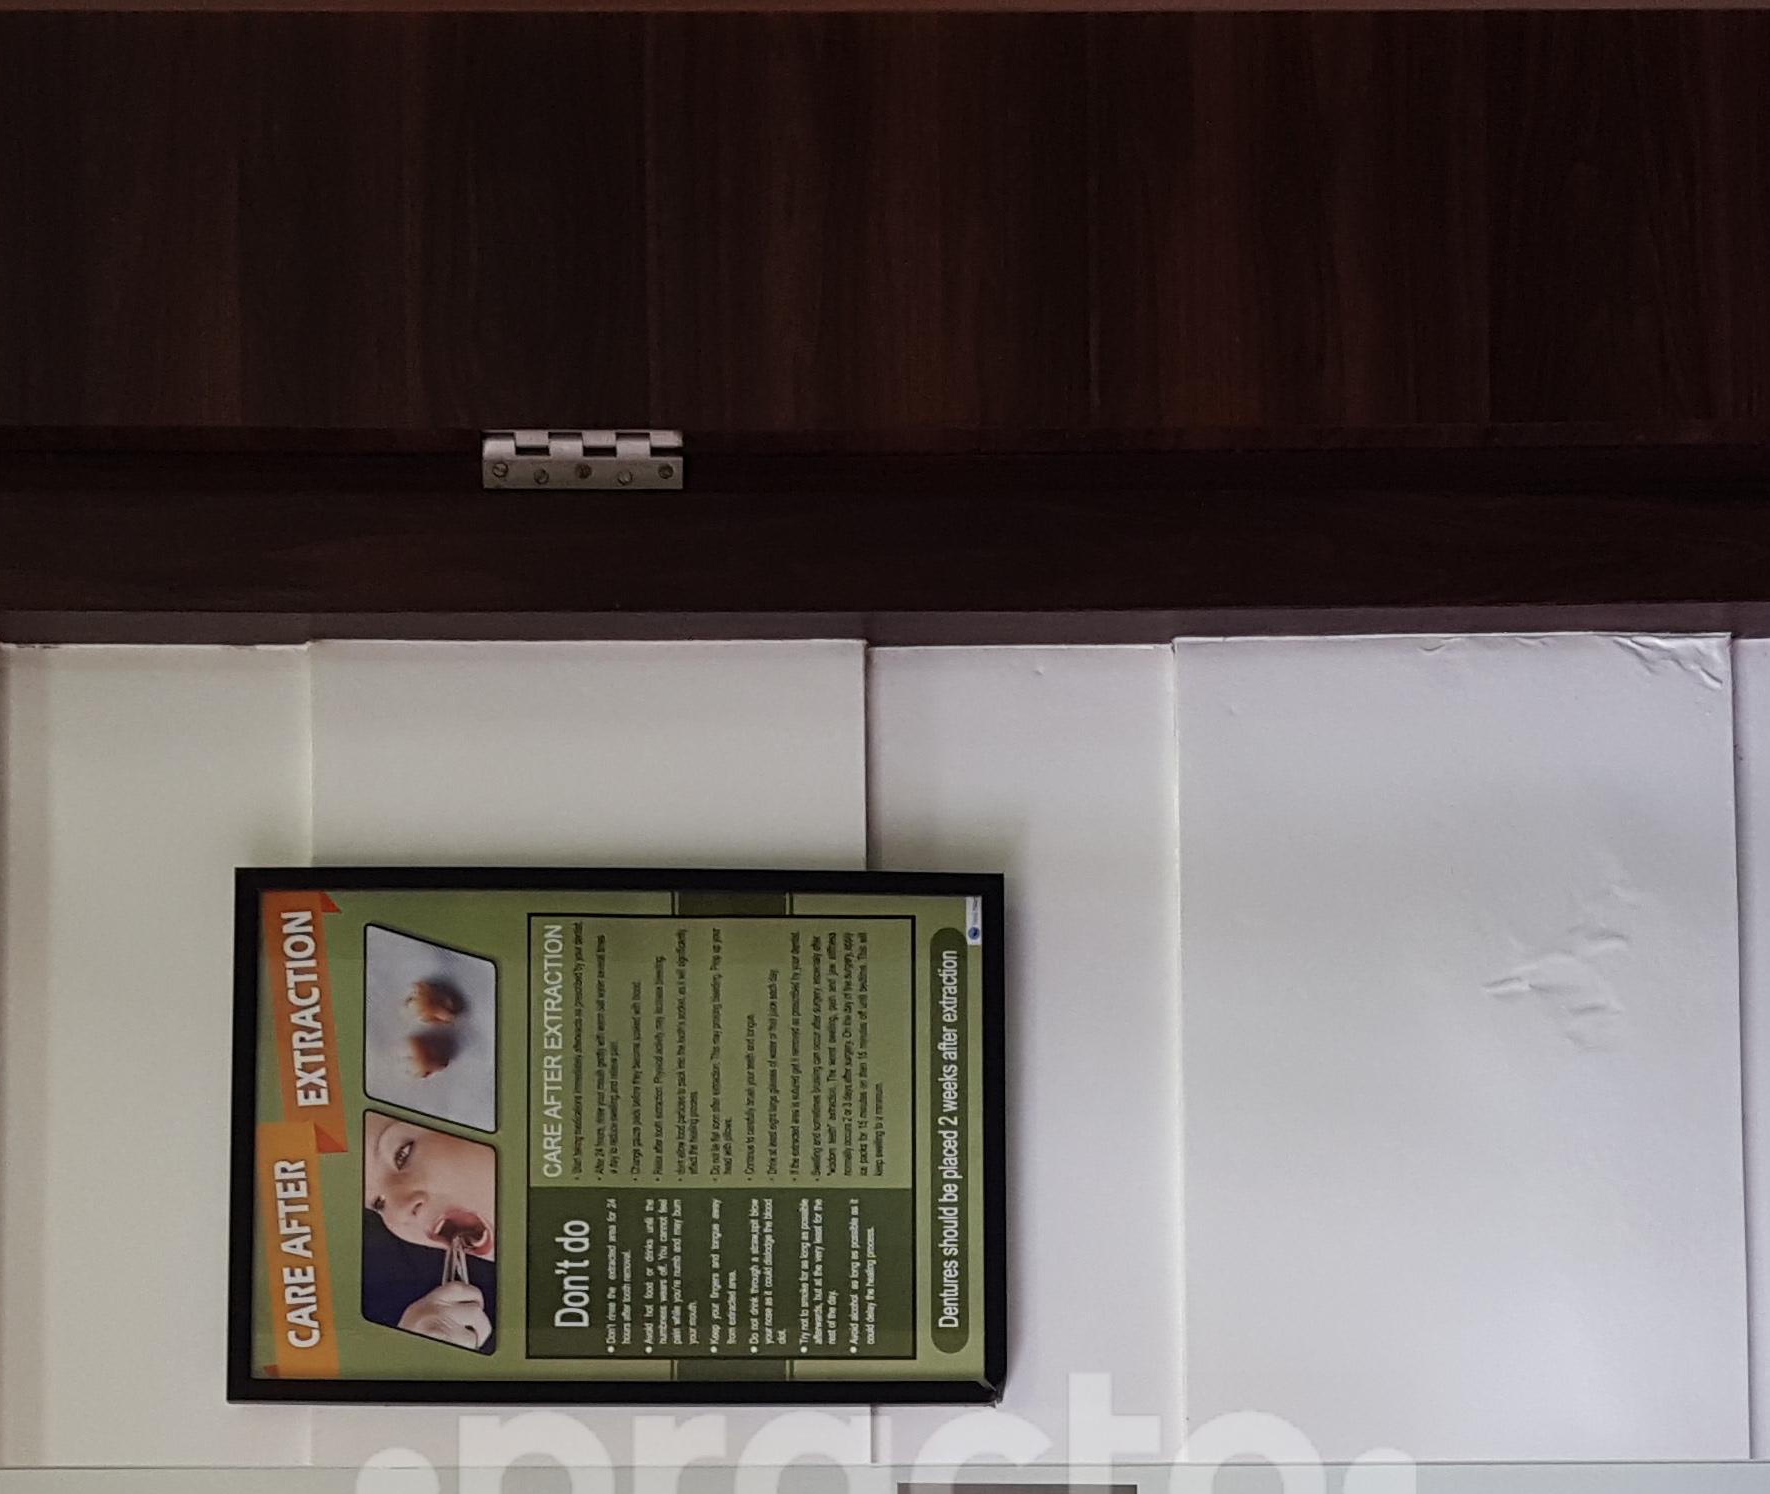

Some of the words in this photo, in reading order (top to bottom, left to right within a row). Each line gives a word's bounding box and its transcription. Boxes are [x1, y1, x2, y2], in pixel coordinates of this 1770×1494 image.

[544, 925, 563, 1049] EXTRACTION
[937, 950, 958, 1023] extraction
[281, 911, 329, 1107] EXTRACTION
[937, 1026, 958, 1061] after
[544, 1055, 563, 1119] AFTER
[938, 1064, 958, 1112] weeks
[938, 1116, 958, 1126] 2
[544, 1123, 563, 1177] CARE
[938, 1130, 963, 1179] placed
[938, 1184, 959, 1203] be
[274, 1160, 313, 1258] AFTER
[606, 1198, 616, 1209] 24
[643, 1199, 654, 1212] the
[813, 1199, 823, 1212] the
[606, 1211, 616, 1223] for
[850, 1206, 859, 1216] as
[813, 1213, 823, 1224] for
[673, 1219, 684, 1236] may
[763, 1221, 773, 1234] the
[938, 1207, 959, 1256] should
[555, 1220, 590, 1253] do
[801, 1231, 809, 1241] as
[671, 1238, 682, 1254] and
[657, 1246, 668, 1261] You
[850, 1250, 859, 1260] as
[710, 1254, 720, 1269] and
[801, 1260, 809, 1270] as
[645, 1267, 654, 1277] or
[799, 1271, 809, 1282] for
[813, 1264, 823, 1277] the
[813, 1278, 823, 1287] at
[850, 1280, 859, 1290] as
[554, 1259, 590, 1328] Don't
[606, 1287, 616, 1300] the
[813, 1288, 823, 1301] but
[865, 1288, 875, 1301] the
[938, 1260, 960, 1328] Dentures
[283, 1266, 321, 1349] CARE
[765, 1297, 773, 1307] as
[643, 1305, 654, 1318] hot
[799, 1309, 809, 1318] to
[826, 1307, 837, 1320] the
[749, 1318, 759, 1331] not
[799, 1318, 809, 1331] not
[826, 1320, 837, 1329] of
[749, 1332, 759, 1345] Do
[799, 1332, 811, 1344] Try
